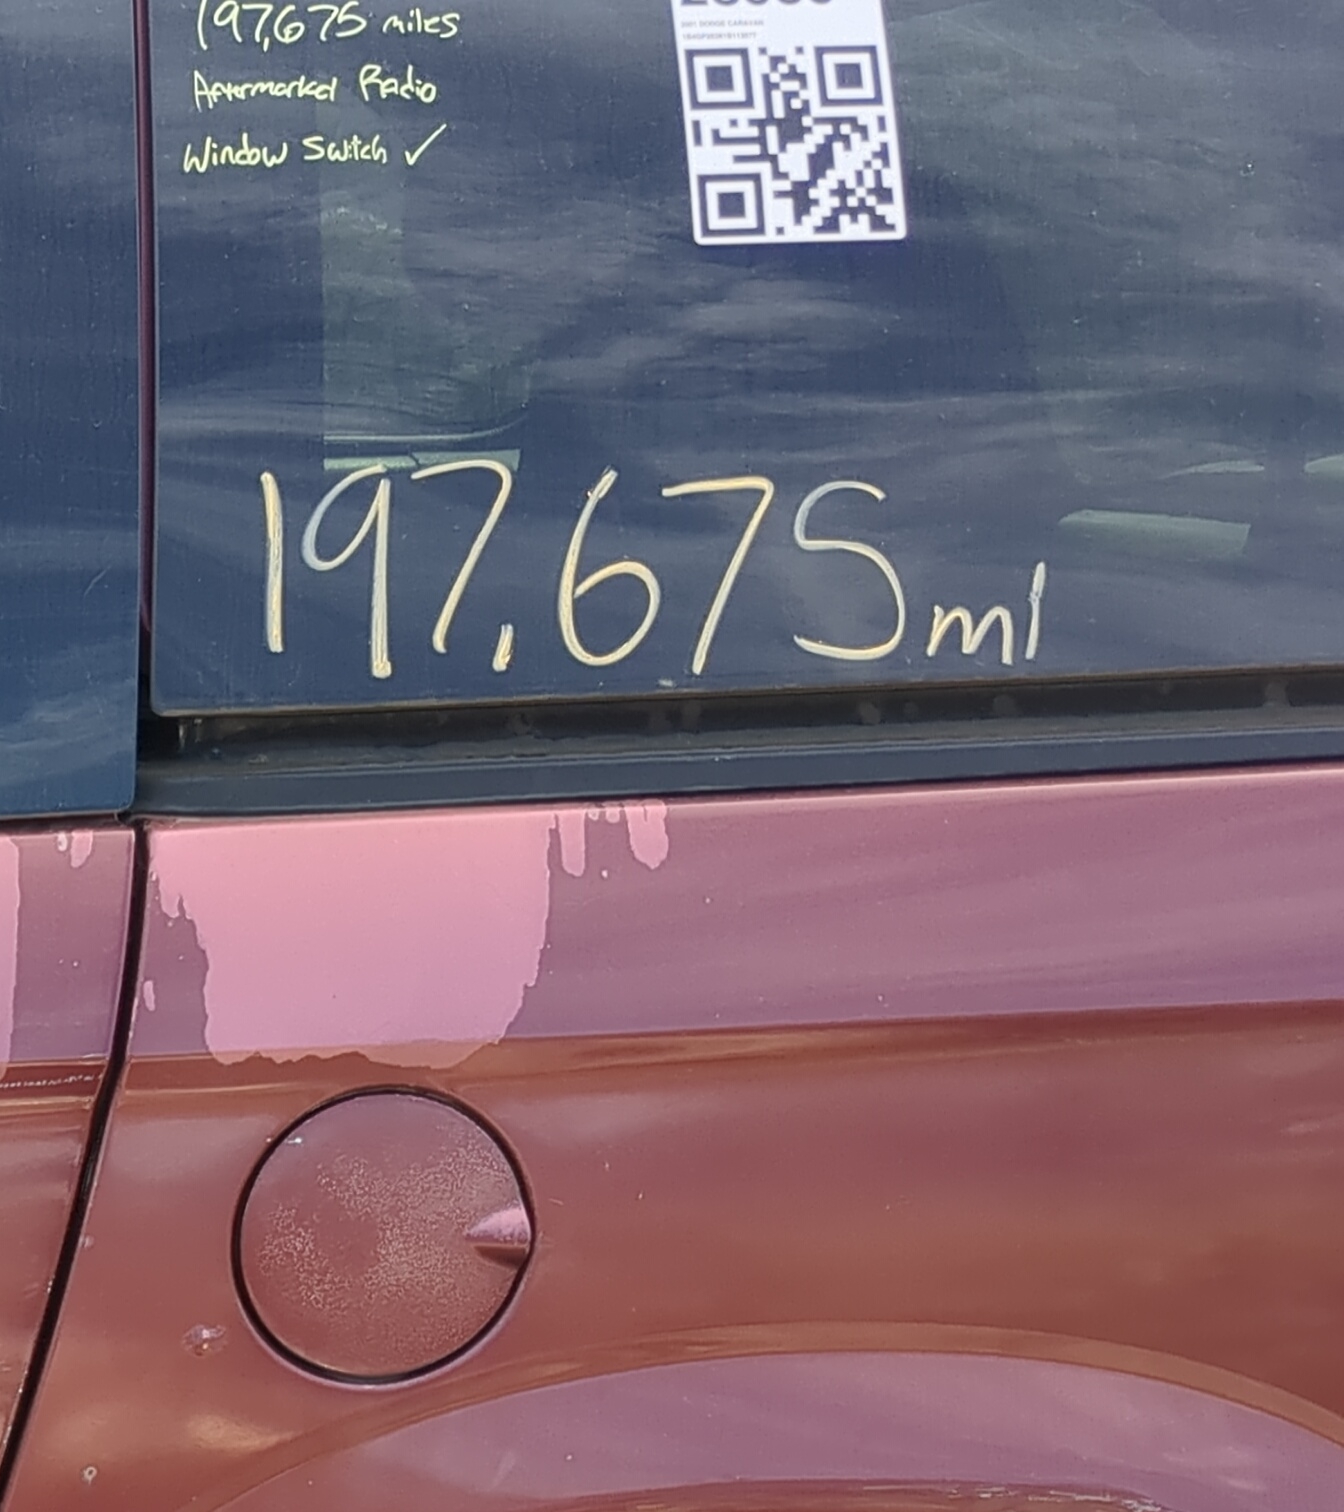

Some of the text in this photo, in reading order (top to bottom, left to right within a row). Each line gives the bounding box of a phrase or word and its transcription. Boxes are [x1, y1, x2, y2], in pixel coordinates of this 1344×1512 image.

[197, 0, 460, 52] 197,675 miles
[358, 63, 436, 103] Radio
[183, 132, 388, 173] Window Switch
[260, 458, 907, 679] 197,675
